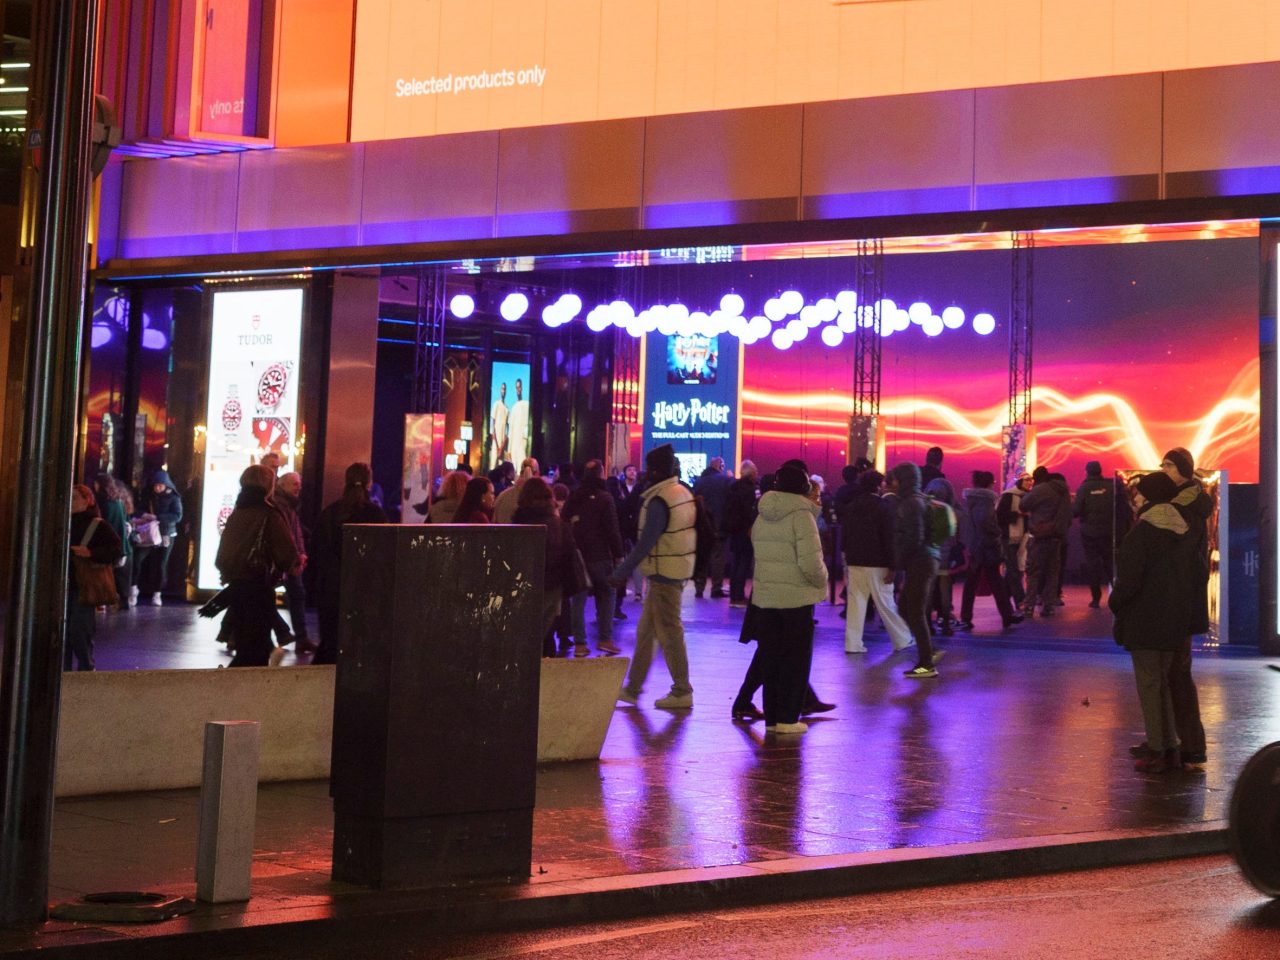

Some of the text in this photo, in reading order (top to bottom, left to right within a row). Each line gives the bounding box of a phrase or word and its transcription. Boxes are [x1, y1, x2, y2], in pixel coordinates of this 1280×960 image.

[395, 64, 547, 98] Selected products only
[238, 334, 273, 346] TUDOR
[652, 398, 730, 429] Harry Potter
